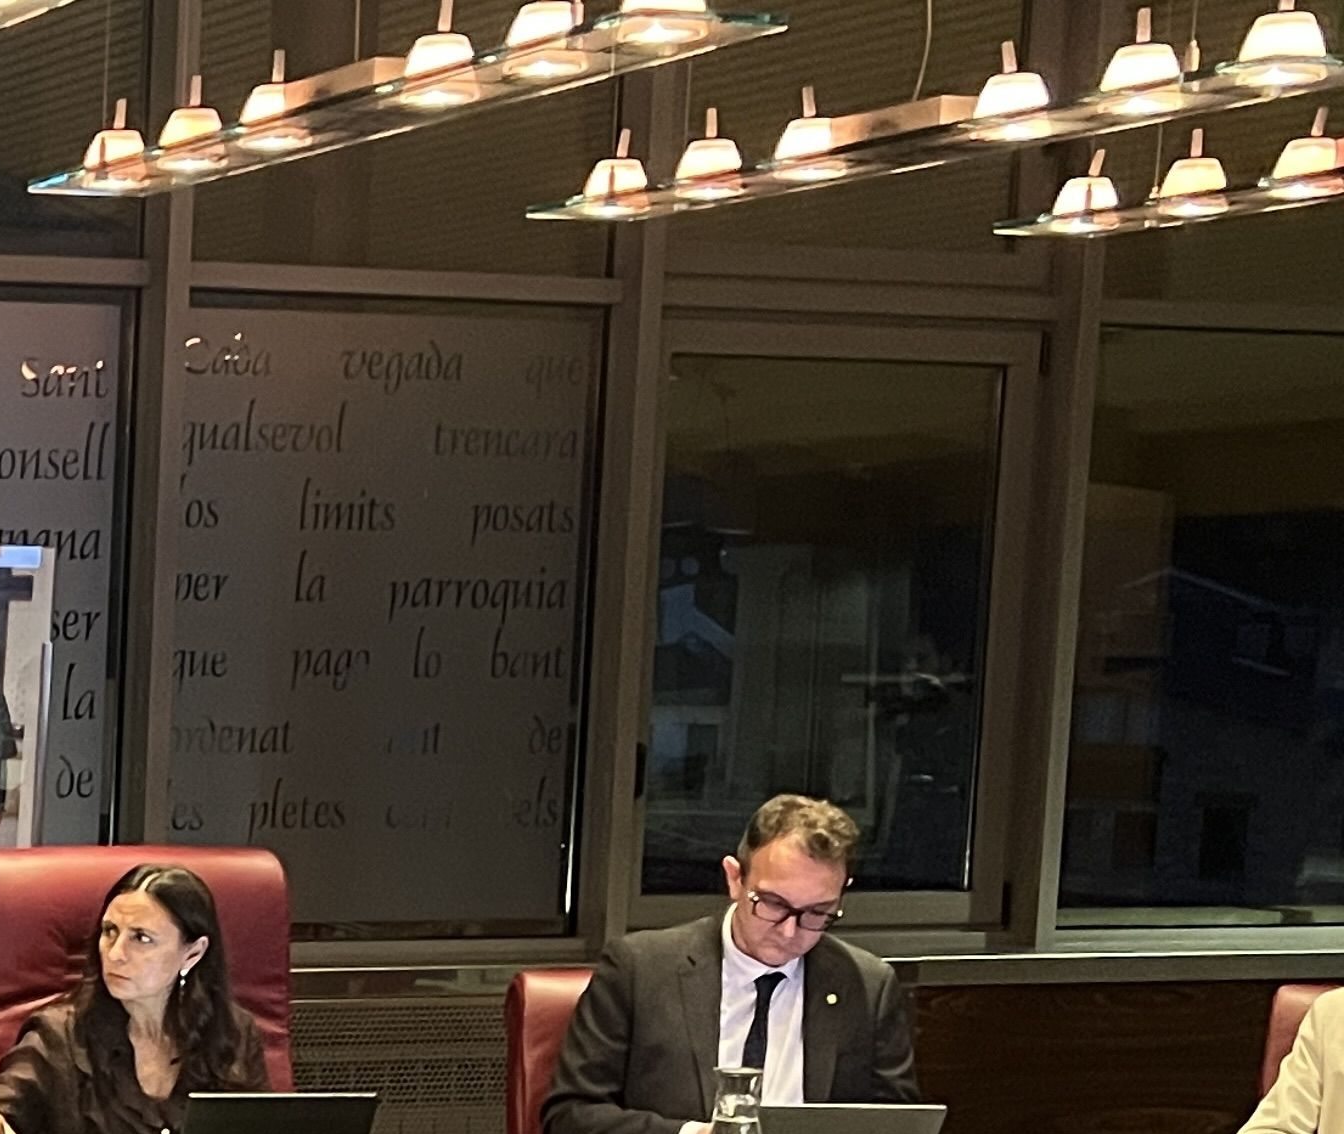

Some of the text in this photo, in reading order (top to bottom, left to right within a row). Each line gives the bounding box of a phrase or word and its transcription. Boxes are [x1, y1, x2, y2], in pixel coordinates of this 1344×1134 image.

[21, 357, 110, 399] Sant
[341, 339, 464, 396] vegada
[300, 477, 396, 531] limits
[471, 500, 576, 547] posats
[295, 550, 326, 602] la
[388, 565, 569, 625] parroquia
[51, 608, 101, 642] ser
[413, 626, 442, 679] lo
[62, 662, 97, 722] la
[529, 714, 562, 755] de
[55, 755, 95, 799] de
[248, 777, 347, 843] pletes
